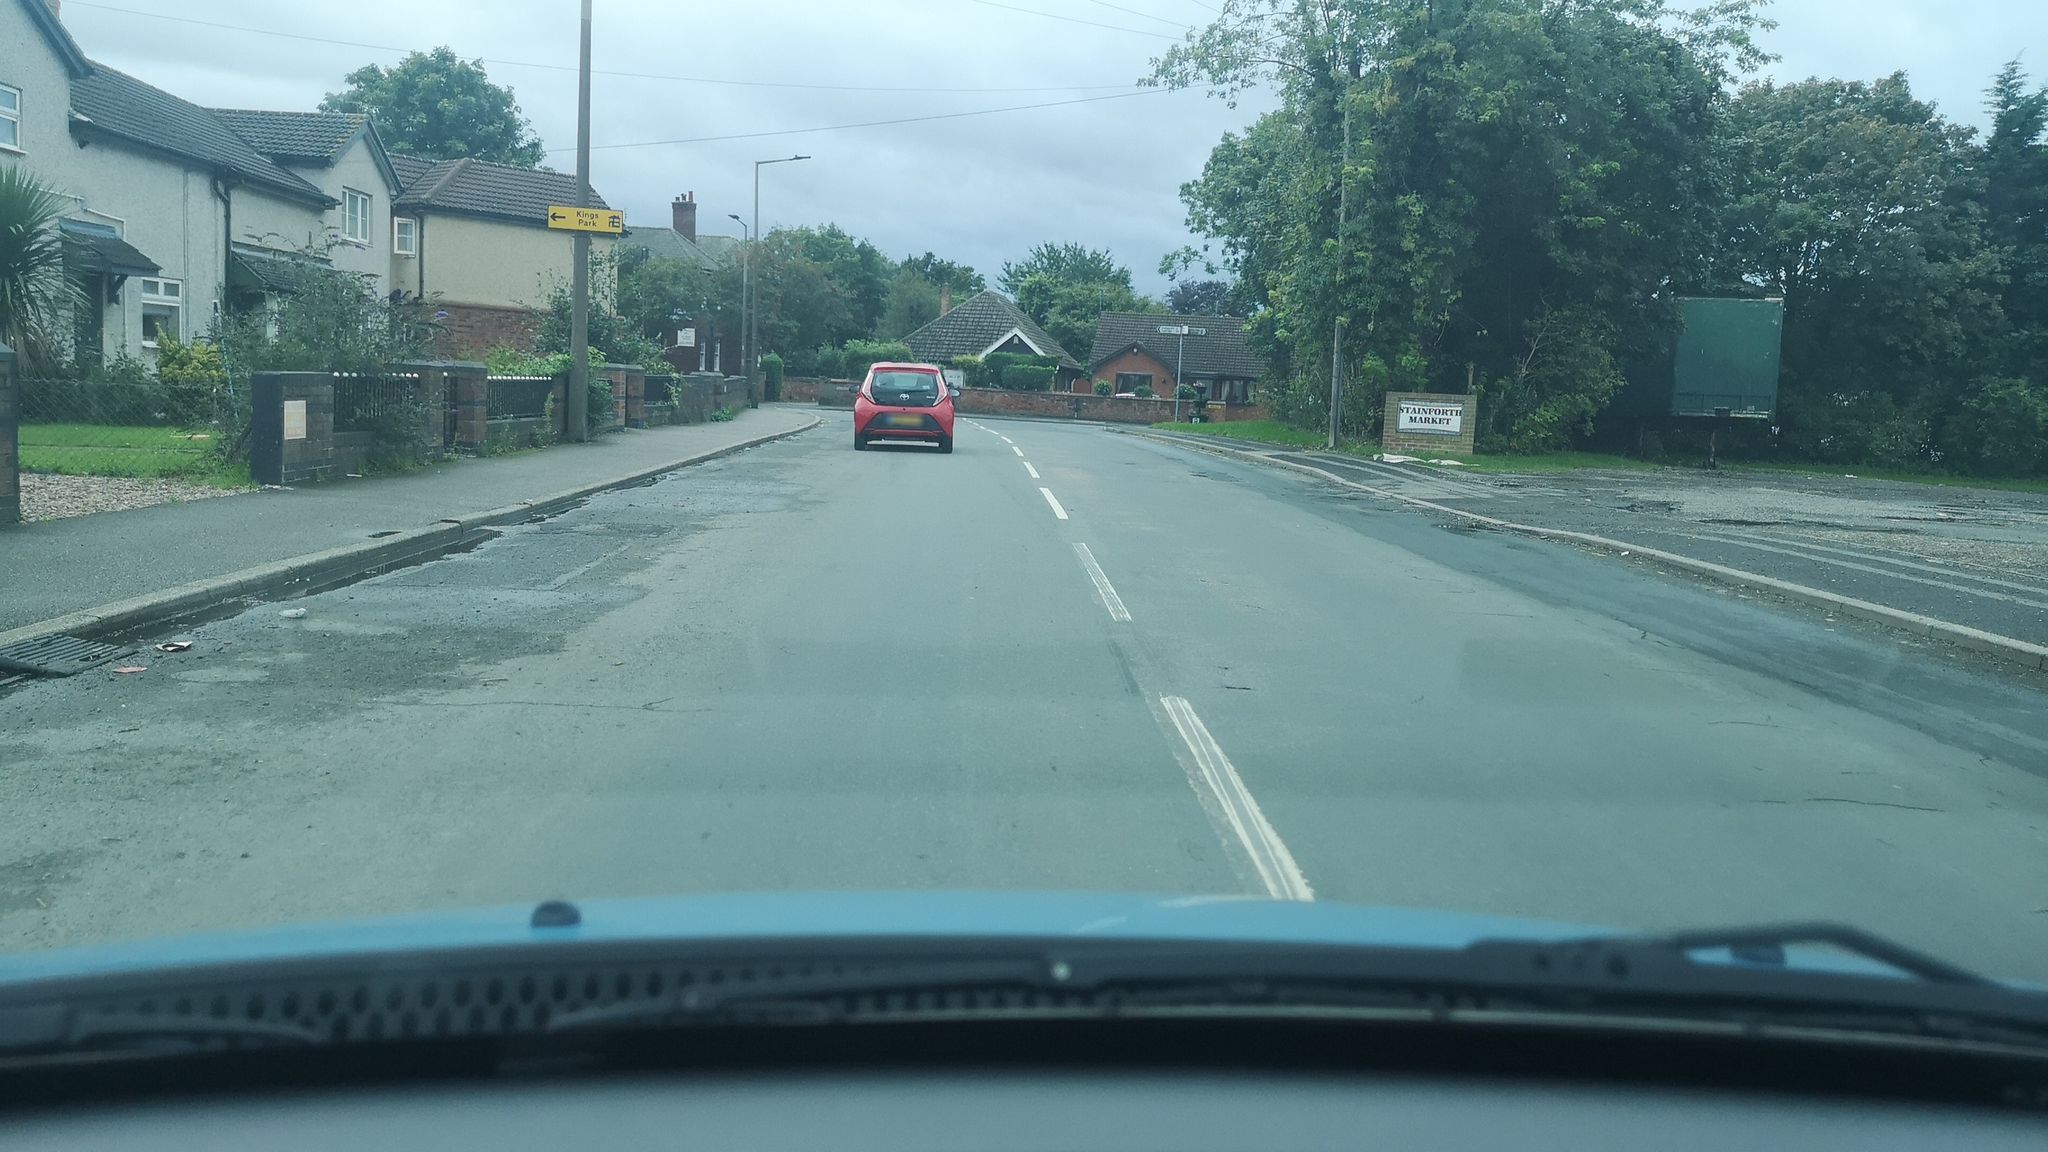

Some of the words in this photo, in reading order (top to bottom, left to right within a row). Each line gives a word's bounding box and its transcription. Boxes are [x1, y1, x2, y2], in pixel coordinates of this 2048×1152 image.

[576, 210, 599, 219] Kings
[578, 219, 597, 227] Park
[1400, 406, 1462, 417] STAINFORTH
[1409, 416, 1452, 425] MARKET
